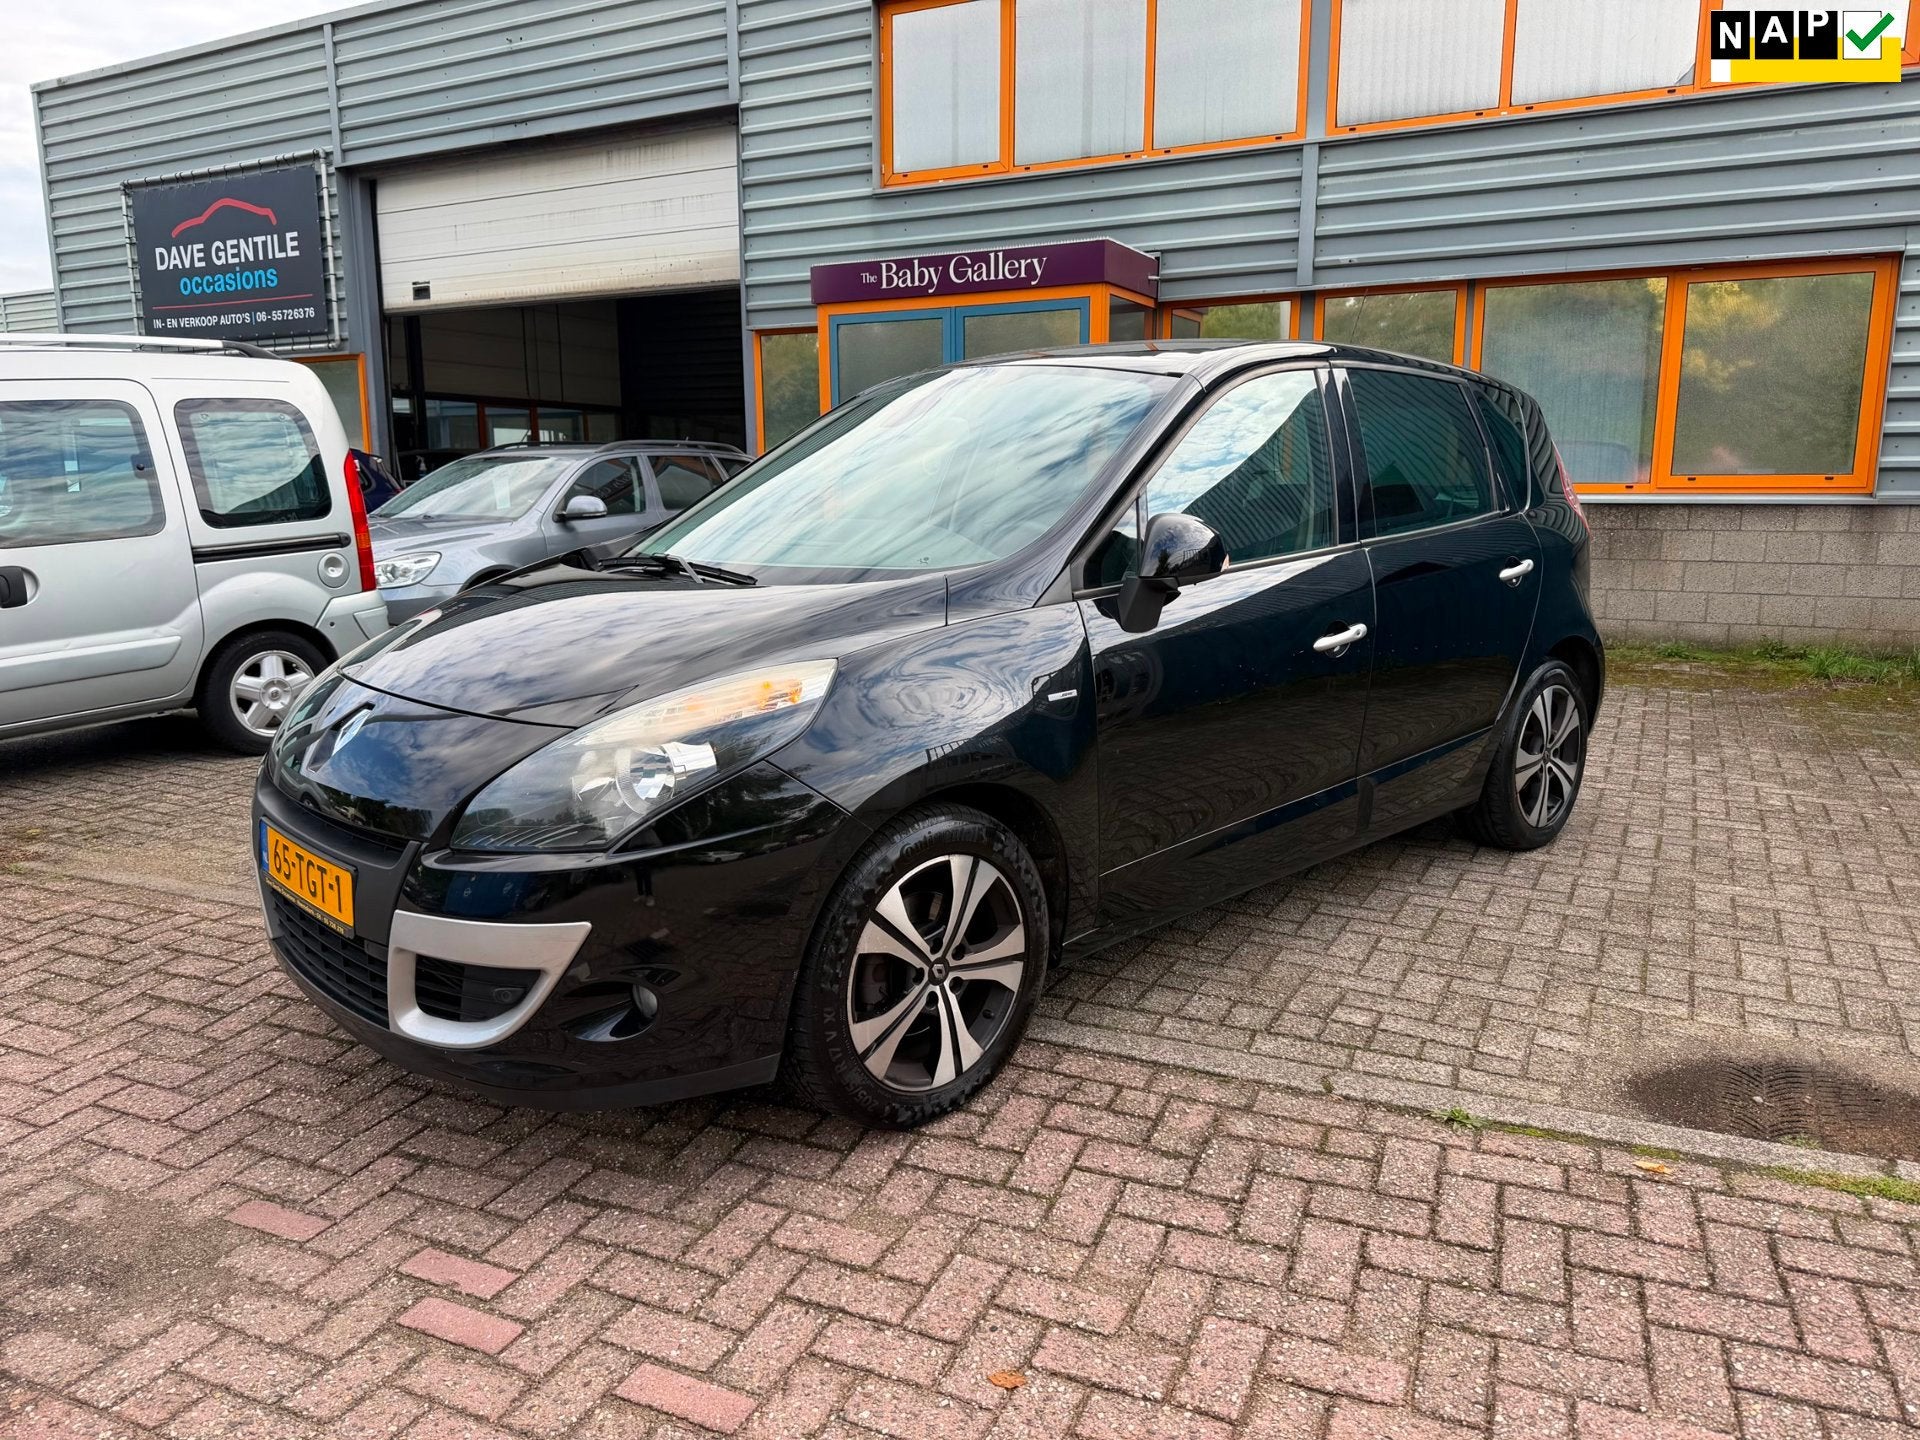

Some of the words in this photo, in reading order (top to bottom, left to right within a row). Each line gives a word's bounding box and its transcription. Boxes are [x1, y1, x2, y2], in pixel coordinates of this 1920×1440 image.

[155, 243, 206, 271] DAVE
[211, 231, 300, 266] GENTILE
[179, 266, 278, 296] occasions
[860, 272, 878, 284] The
[880, 259, 942, 293] Baby
[949, 251, 1048, 285] Gallery
[153, 319, 165, 329] IN-
[167, 317, 177, 328] EN
[179, 315, 218, 327] VERKOOP
[220, 312, 251, 326] AUTO'S
[273, 838, 342, 914] 65-TGT-1
